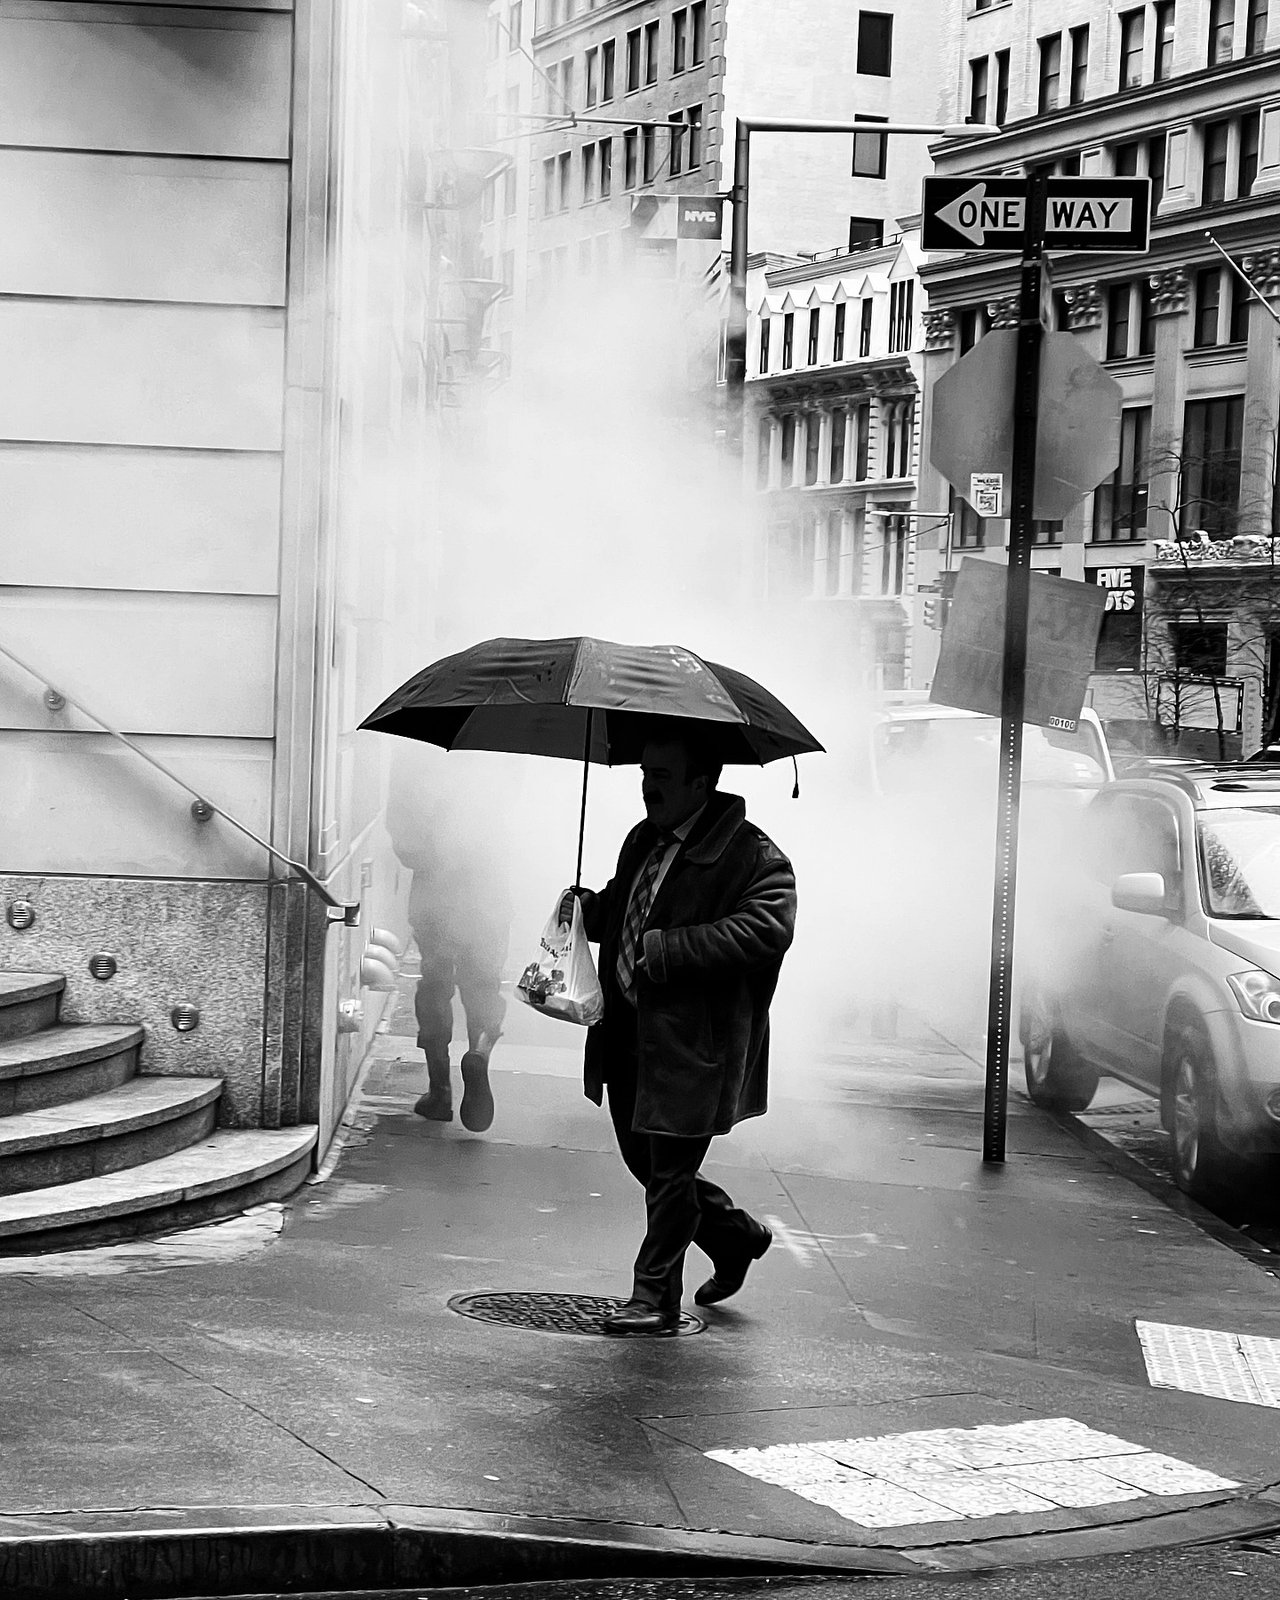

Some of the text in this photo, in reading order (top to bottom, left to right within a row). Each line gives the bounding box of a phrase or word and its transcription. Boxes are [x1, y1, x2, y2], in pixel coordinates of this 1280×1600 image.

[684, 210, 717, 223] NYC
[958, 200, 1119, 229] ONE WAY
